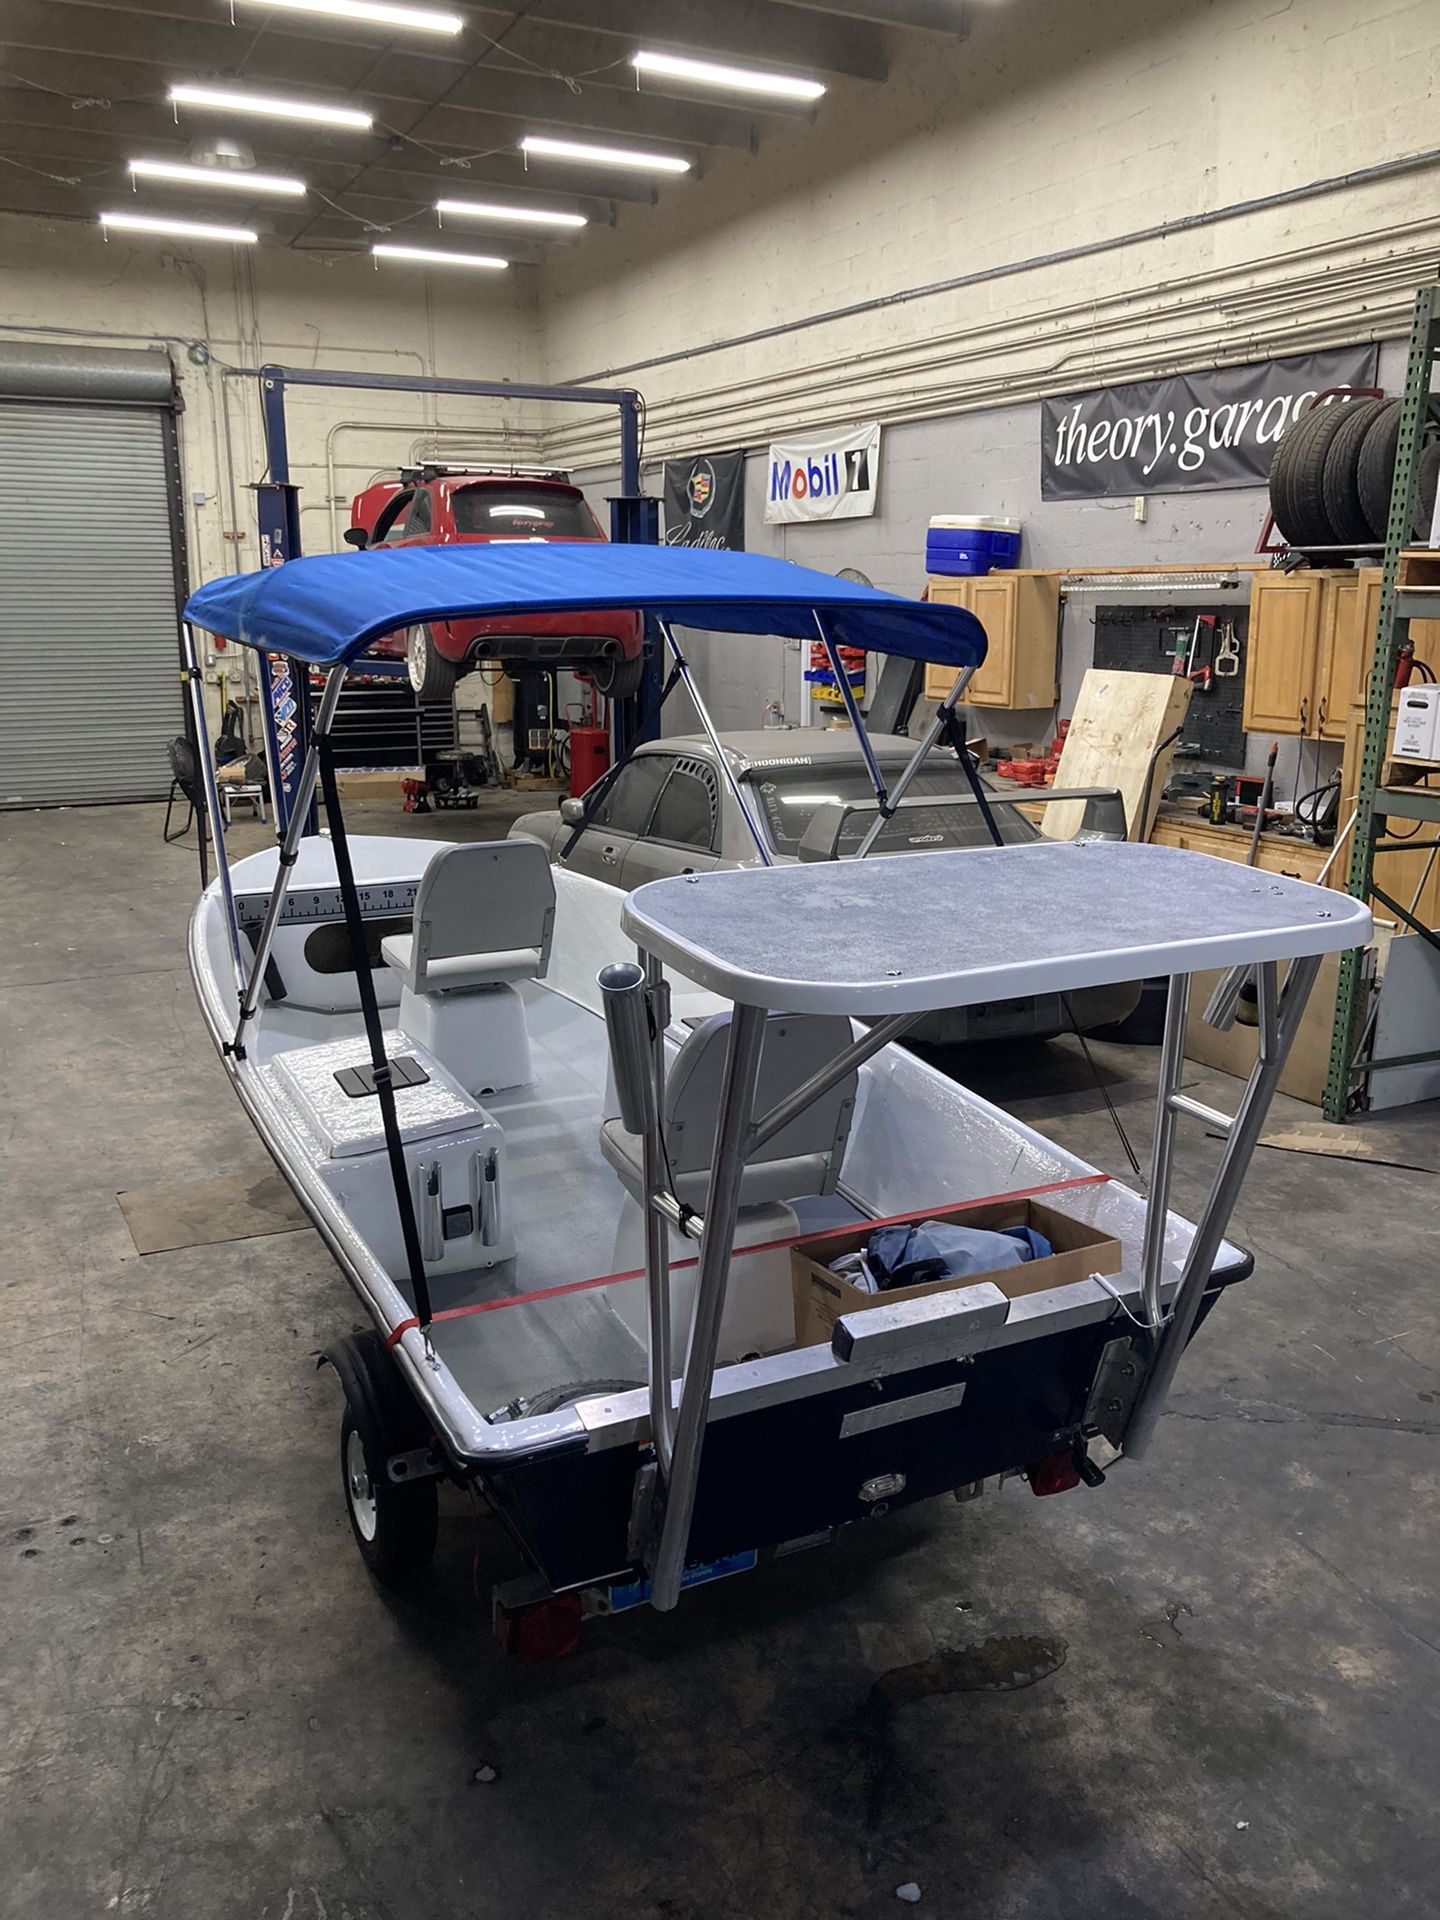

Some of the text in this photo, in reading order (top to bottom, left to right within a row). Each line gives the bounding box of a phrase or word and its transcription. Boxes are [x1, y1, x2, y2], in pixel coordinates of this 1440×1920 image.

[1055, 384, 1351, 475] theory.gara
[771, 450, 863, 501] Mobil 1
[238, 902, 245, 910] 0
[263, 900, 269, 908] 3
[288, 898, 295, 906] 6
[313, 896, 320, 904] 9
[359, 892, 370, 901] 15
[382, 889, 394, 898] 18
[406, 888, 417, 897] 21
